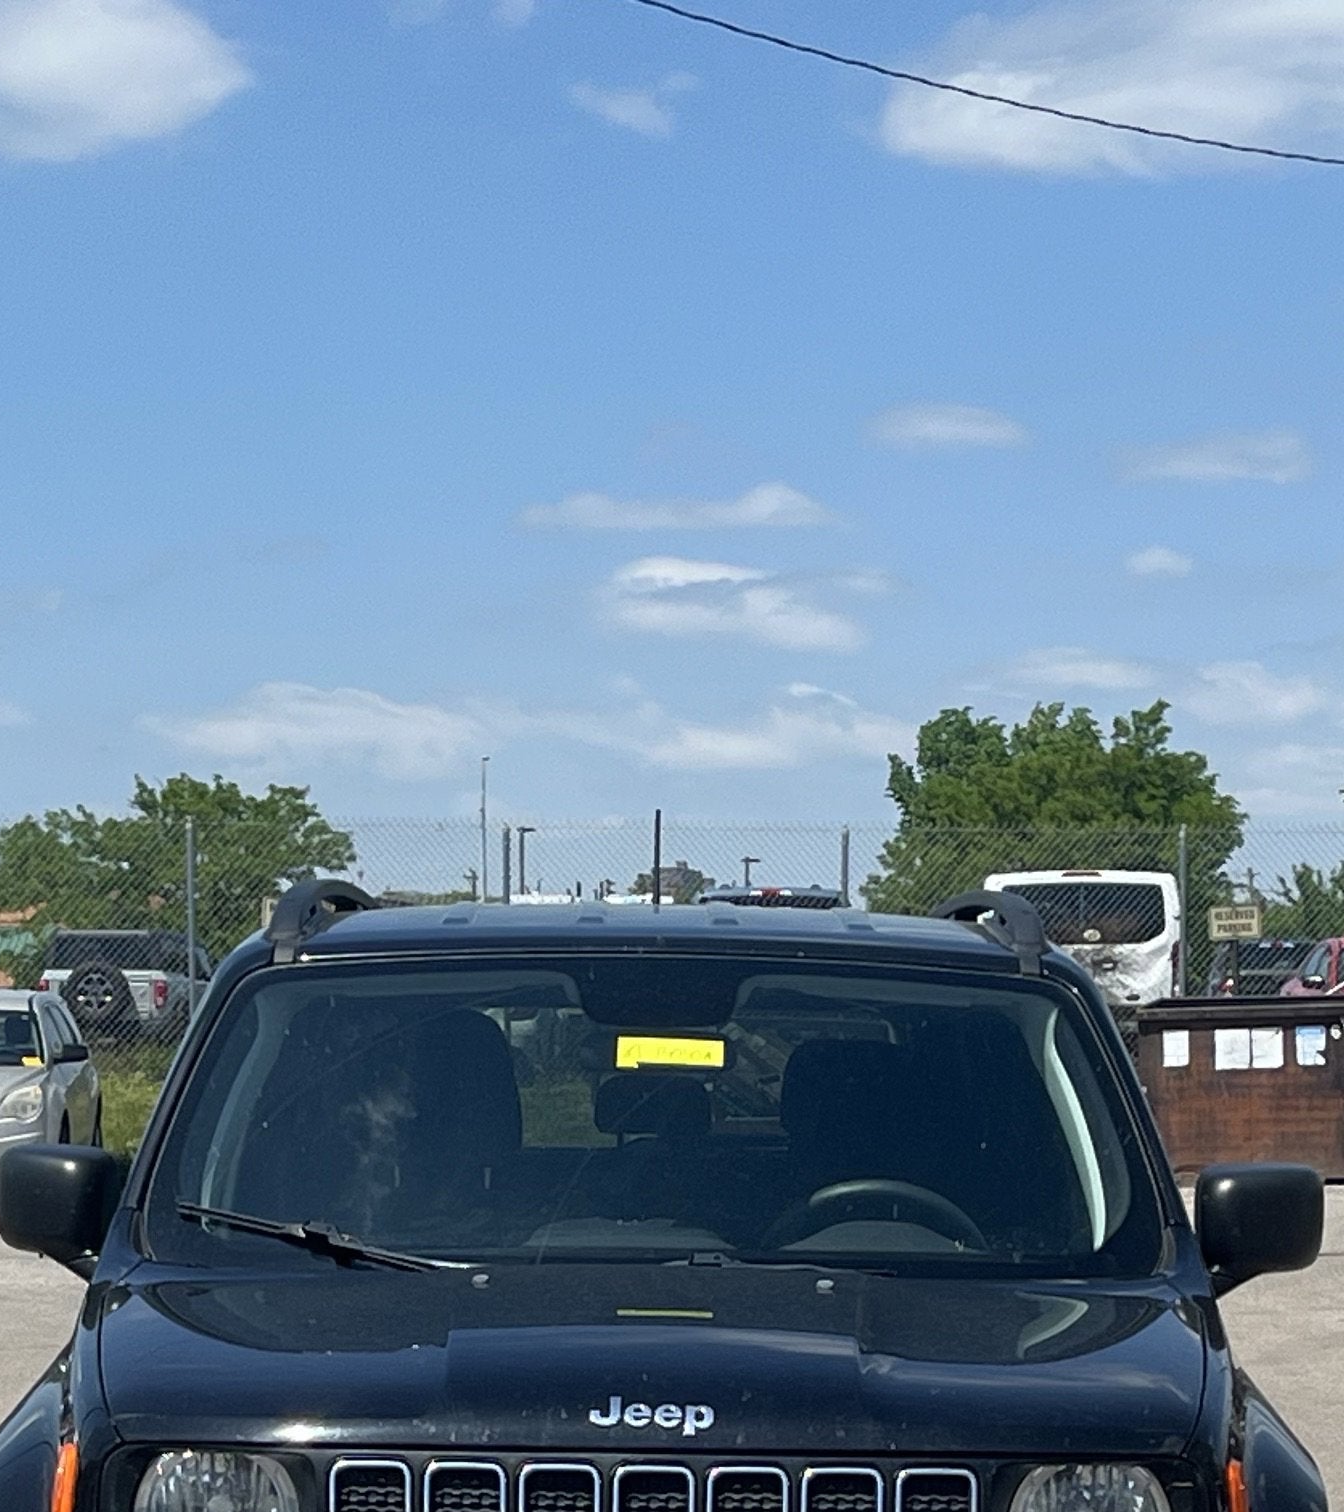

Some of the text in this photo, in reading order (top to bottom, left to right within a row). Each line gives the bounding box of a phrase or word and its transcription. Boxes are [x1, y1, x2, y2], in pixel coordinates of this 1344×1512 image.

[1214, 910, 1255, 920] RESERVED
[1216, 922, 1253, 933] PARKING
[589, 1396, 715, 1436] Jeep
